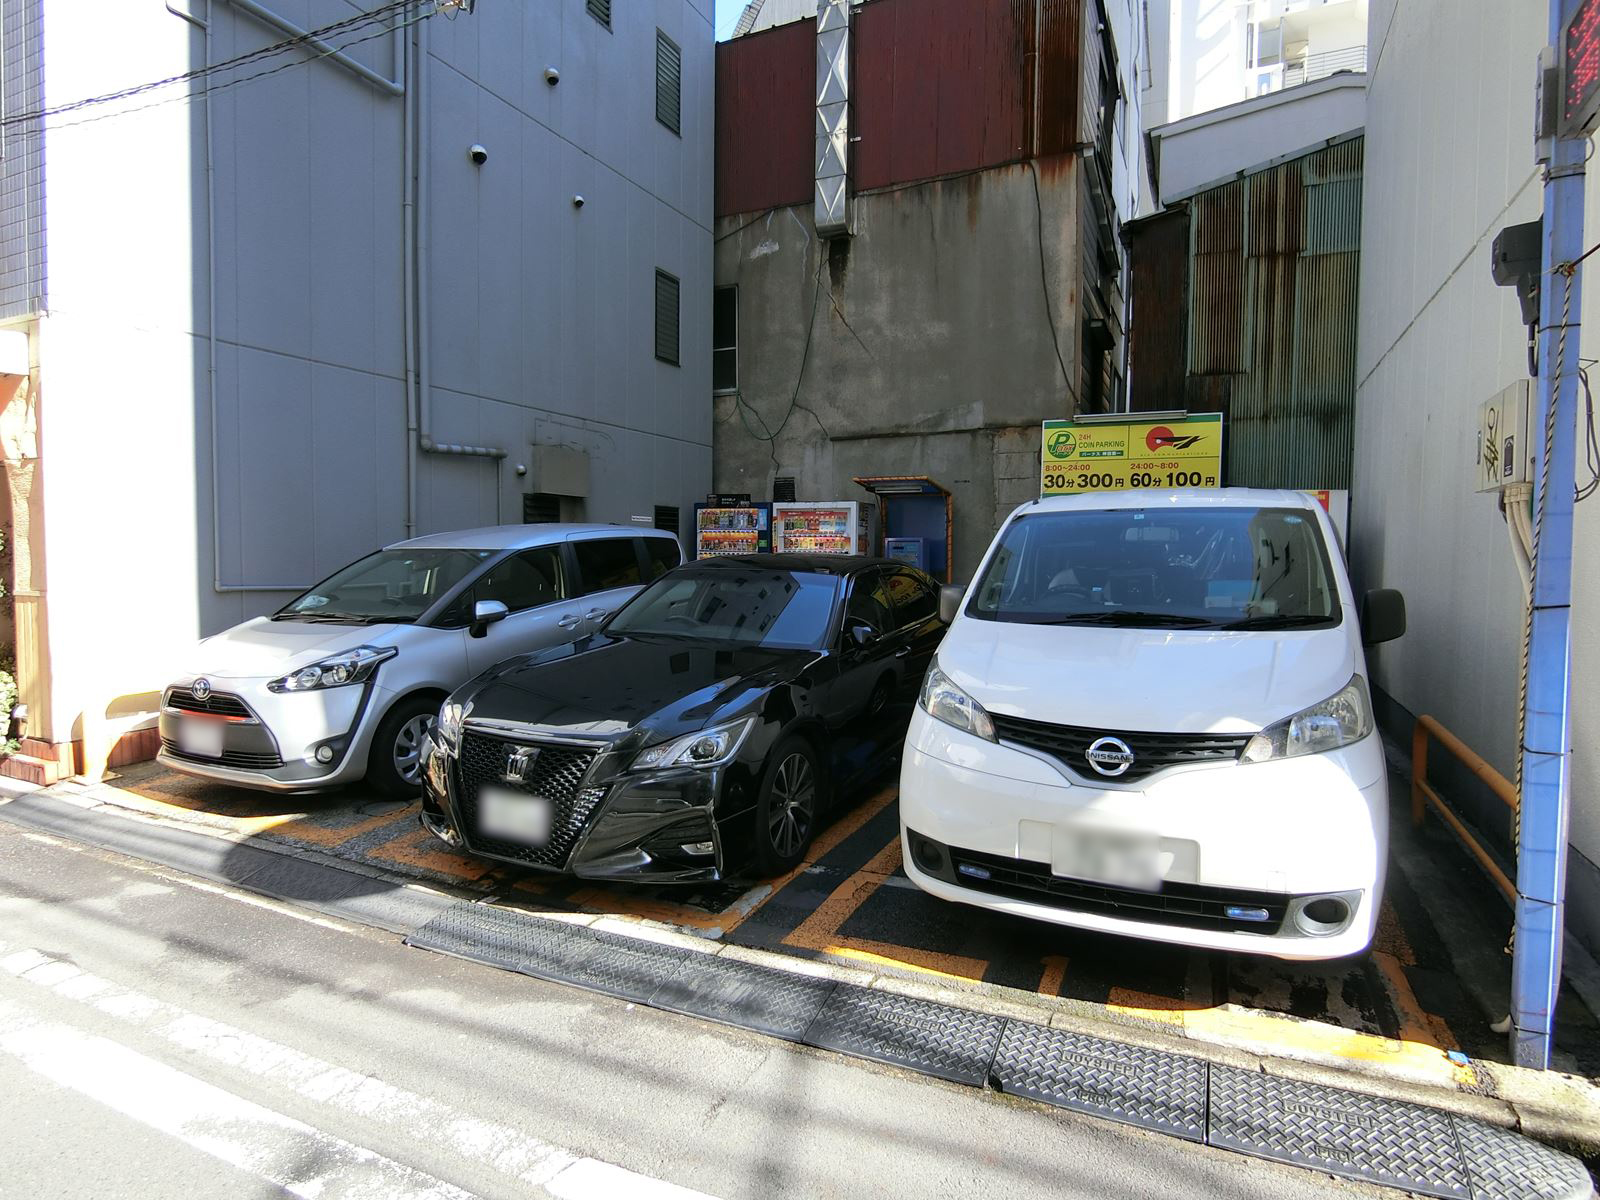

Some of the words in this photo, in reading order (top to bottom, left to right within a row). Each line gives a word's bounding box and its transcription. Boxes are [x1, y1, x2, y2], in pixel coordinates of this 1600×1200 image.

[1090, 752, 1128, 762] NISSAN
[1064, 1052, 1133, 1076] JOYSTEP
[1285, 1101, 1369, 1128] JOYSTEP
